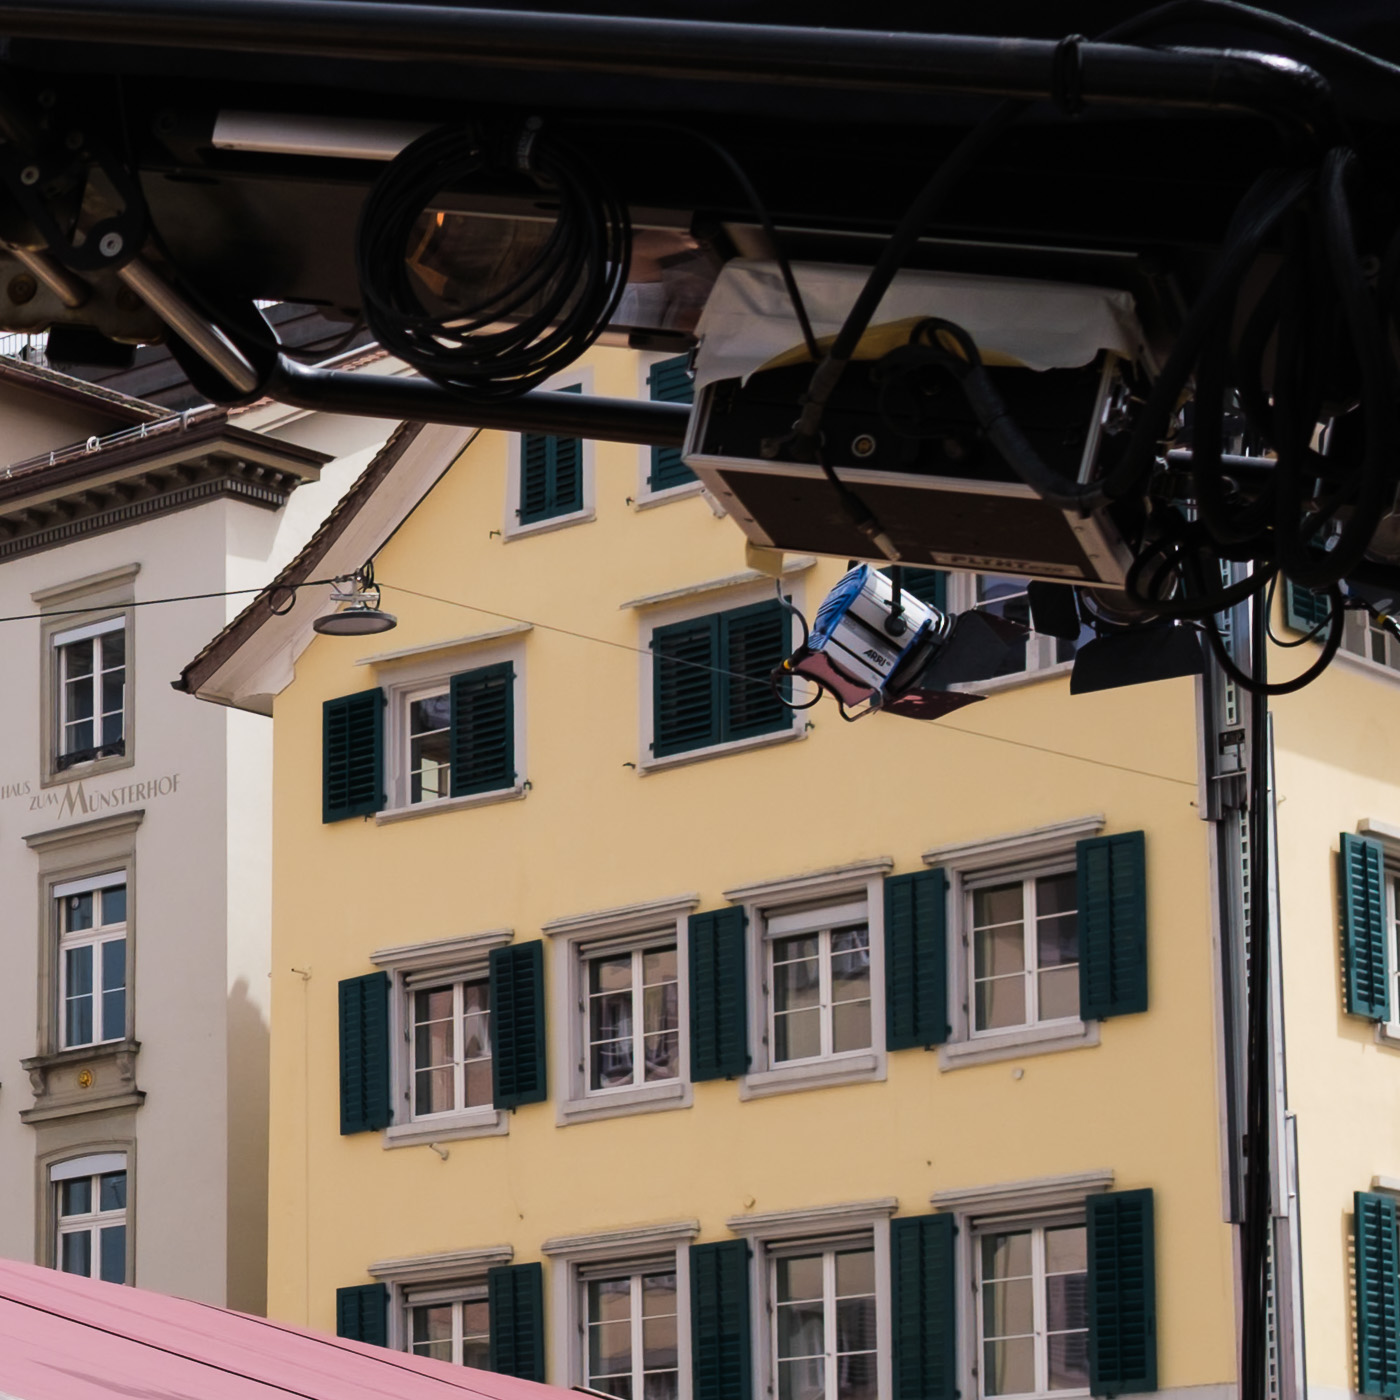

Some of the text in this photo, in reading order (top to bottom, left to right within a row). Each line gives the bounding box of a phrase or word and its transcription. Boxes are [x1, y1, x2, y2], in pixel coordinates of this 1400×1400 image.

[863, 649, 886, 667] ARRI
[1, 780, 31, 800] HAUS
[29, 792, 59, 811] ZUM
